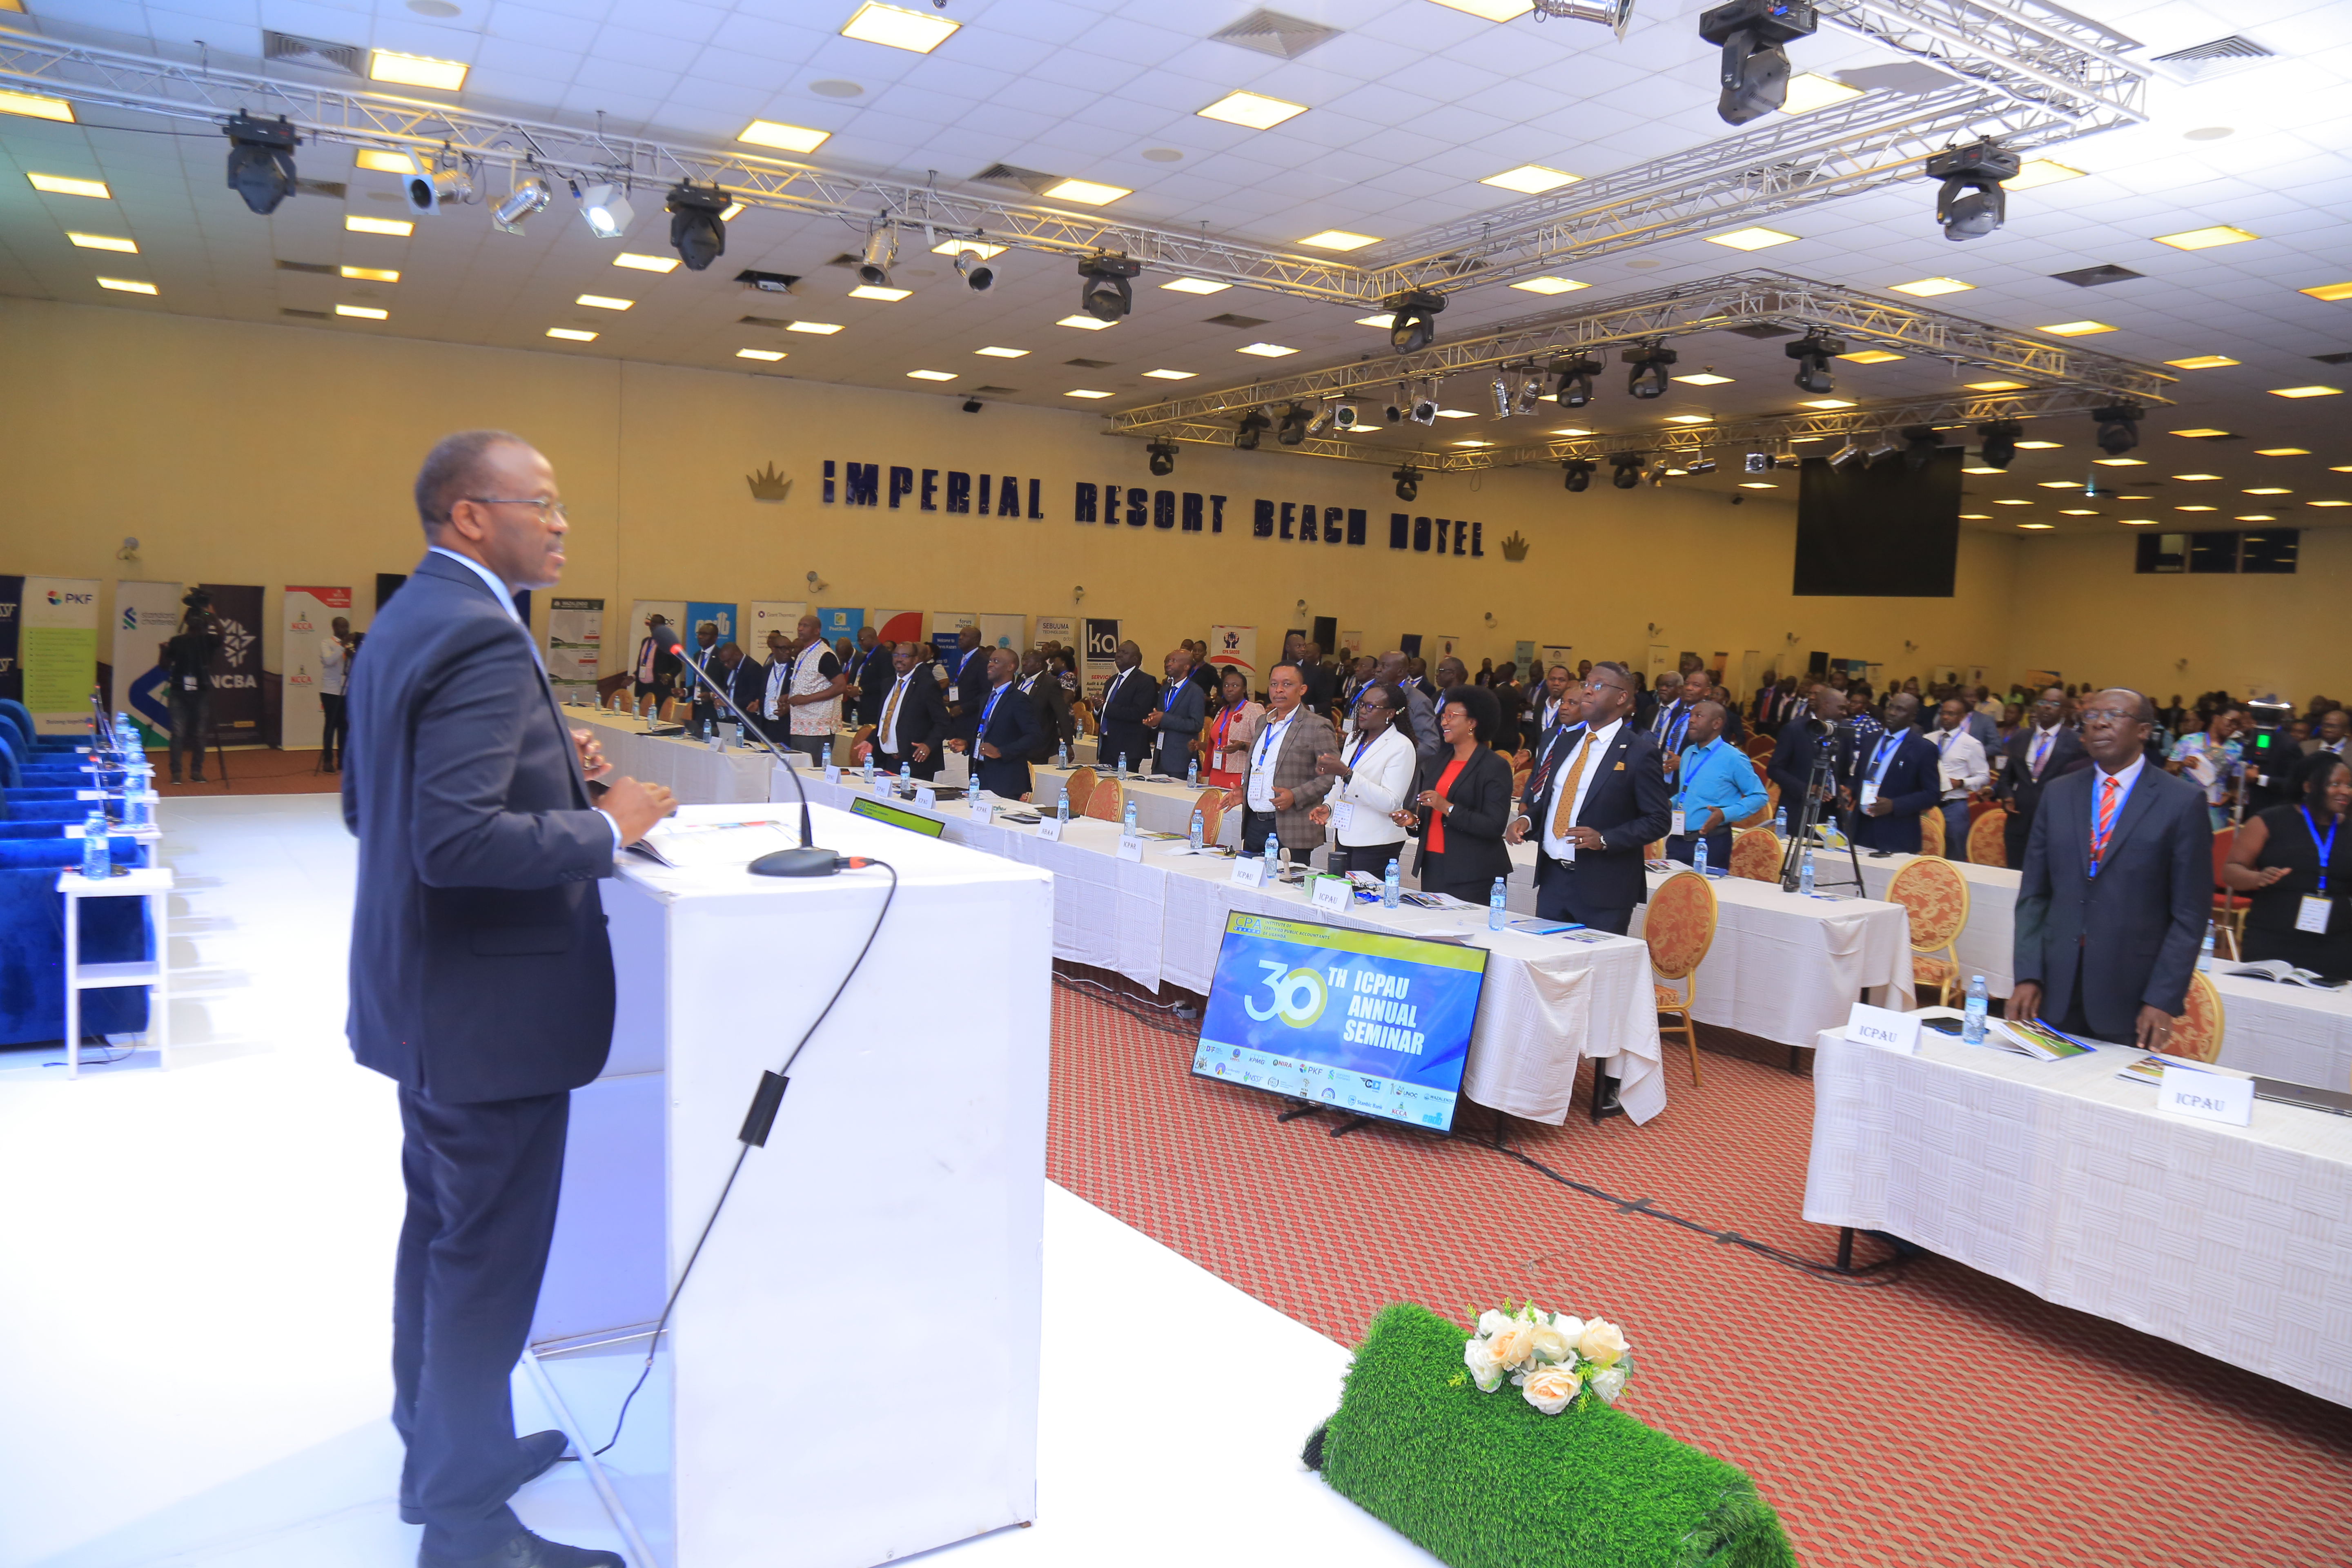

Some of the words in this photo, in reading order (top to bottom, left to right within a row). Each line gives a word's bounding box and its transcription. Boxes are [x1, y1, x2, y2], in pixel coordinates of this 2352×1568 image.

[823, 460, 1044, 519] IMPERIAL
[1075, 482, 1227, 533] RESORT
[1254, 499, 1366, 545] BEACH
[1390, 513, 1484, 557] HOTEL
[65, 594, 93, 605] PKF
[1089, 624, 1116, 653] ka
[1041, 828, 1053, 836] NBAA
[1123, 841, 1136, 850] ICPAR
[1237, 870, 1254, 880] ICPAU
[1319, 892, 1338, 904] ICPAU
[1235, 916, 1261, 930] CPA
[1234, 926, 1260, 934] Uganda
[1299, 931, 1330, 940] ACCOUNTANTS
[1354, 970, 1410, 1000] ICPAU
[1347, 994, 1417, 1029] ANNUAL
[1343, 1019, 1425, 1056] SEMINAR
[1859, 1025, 1898, 1043] ICPAU
[1248, 1056, 1265, 1065] KPMG
[1278, 1060, 1292, 1069] NIRA
[1307, 1066, 1323, 1076] PKF
[1248, 1074, 1263, 1083] NSSF
[1357, 1099, 1372, 1108] Stanbic
[1430, 1095, 1454, 1104] WAZALENDO
[2176, 1092, 2225, 1112] ICPAU
[1392, 1108, 1407, 1117] KCCA
